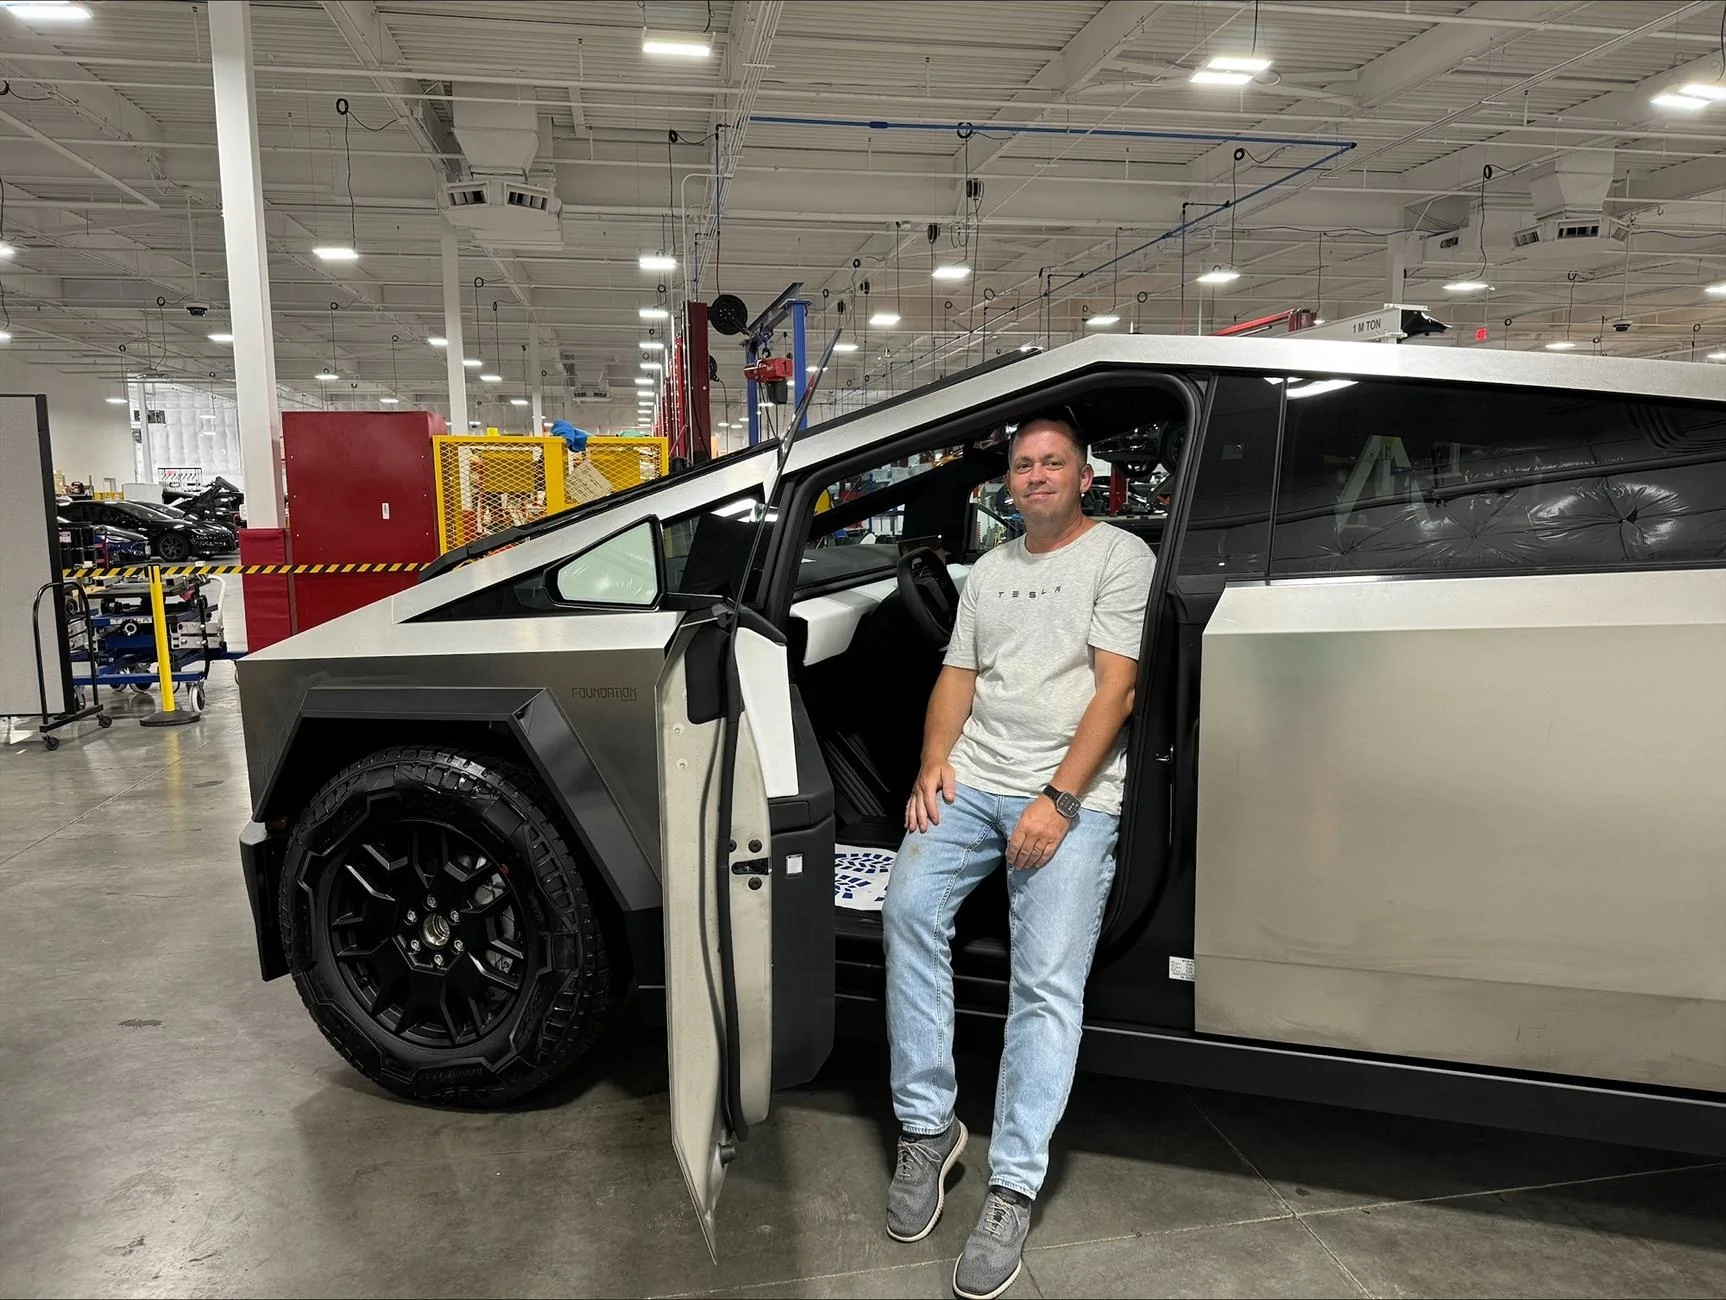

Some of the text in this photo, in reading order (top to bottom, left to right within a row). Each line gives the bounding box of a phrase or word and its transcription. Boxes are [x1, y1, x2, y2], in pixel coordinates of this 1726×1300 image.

[1358, 322, 1365, 332] M
[1366, 319, 1382, 331] TON
[998, 585, 1061, 598] TESLA
[571, 687, 638, 699] FOUNDATION
